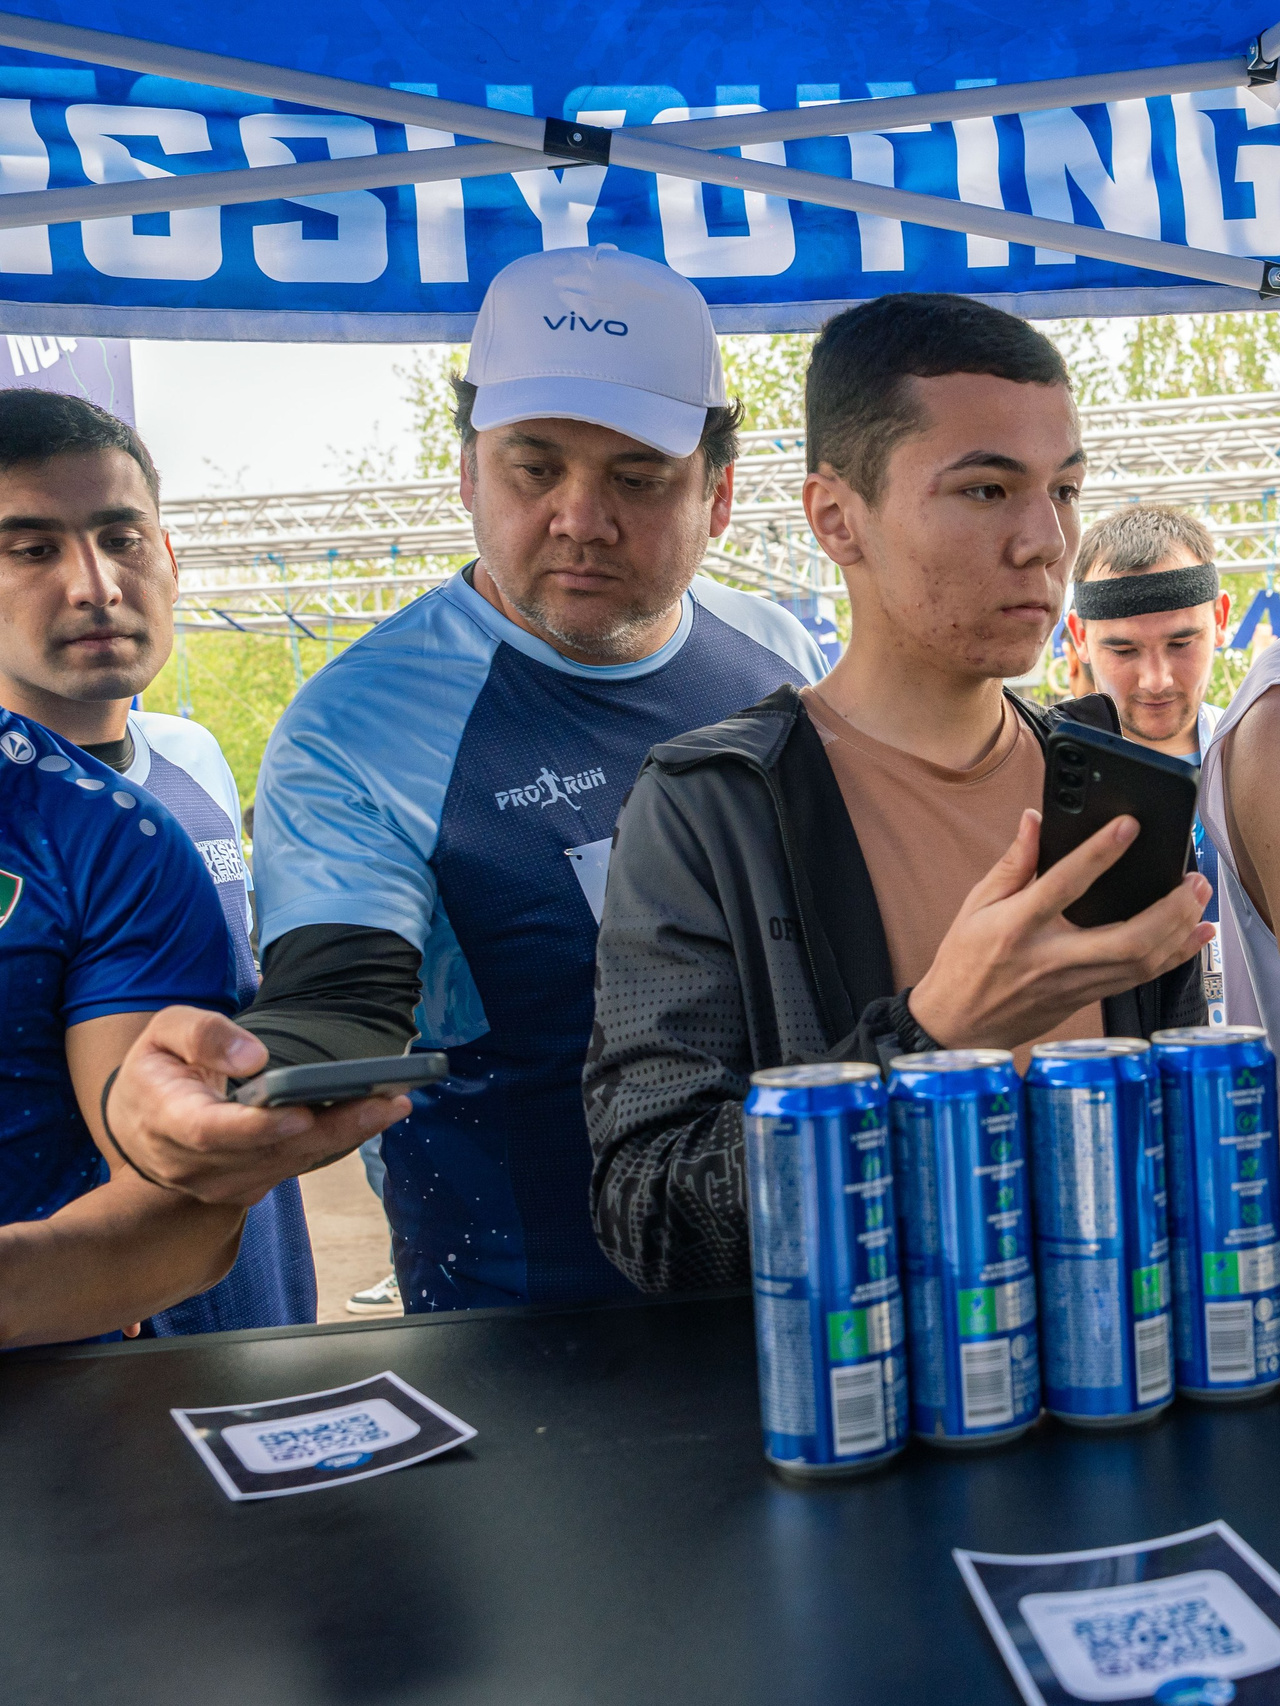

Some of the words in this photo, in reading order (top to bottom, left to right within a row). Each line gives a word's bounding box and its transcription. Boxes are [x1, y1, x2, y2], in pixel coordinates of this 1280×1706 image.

[543, 311, 628, 336] vivo
[494, 784, 541, 811] PRO
[562, 767, 607, 794] RUN
